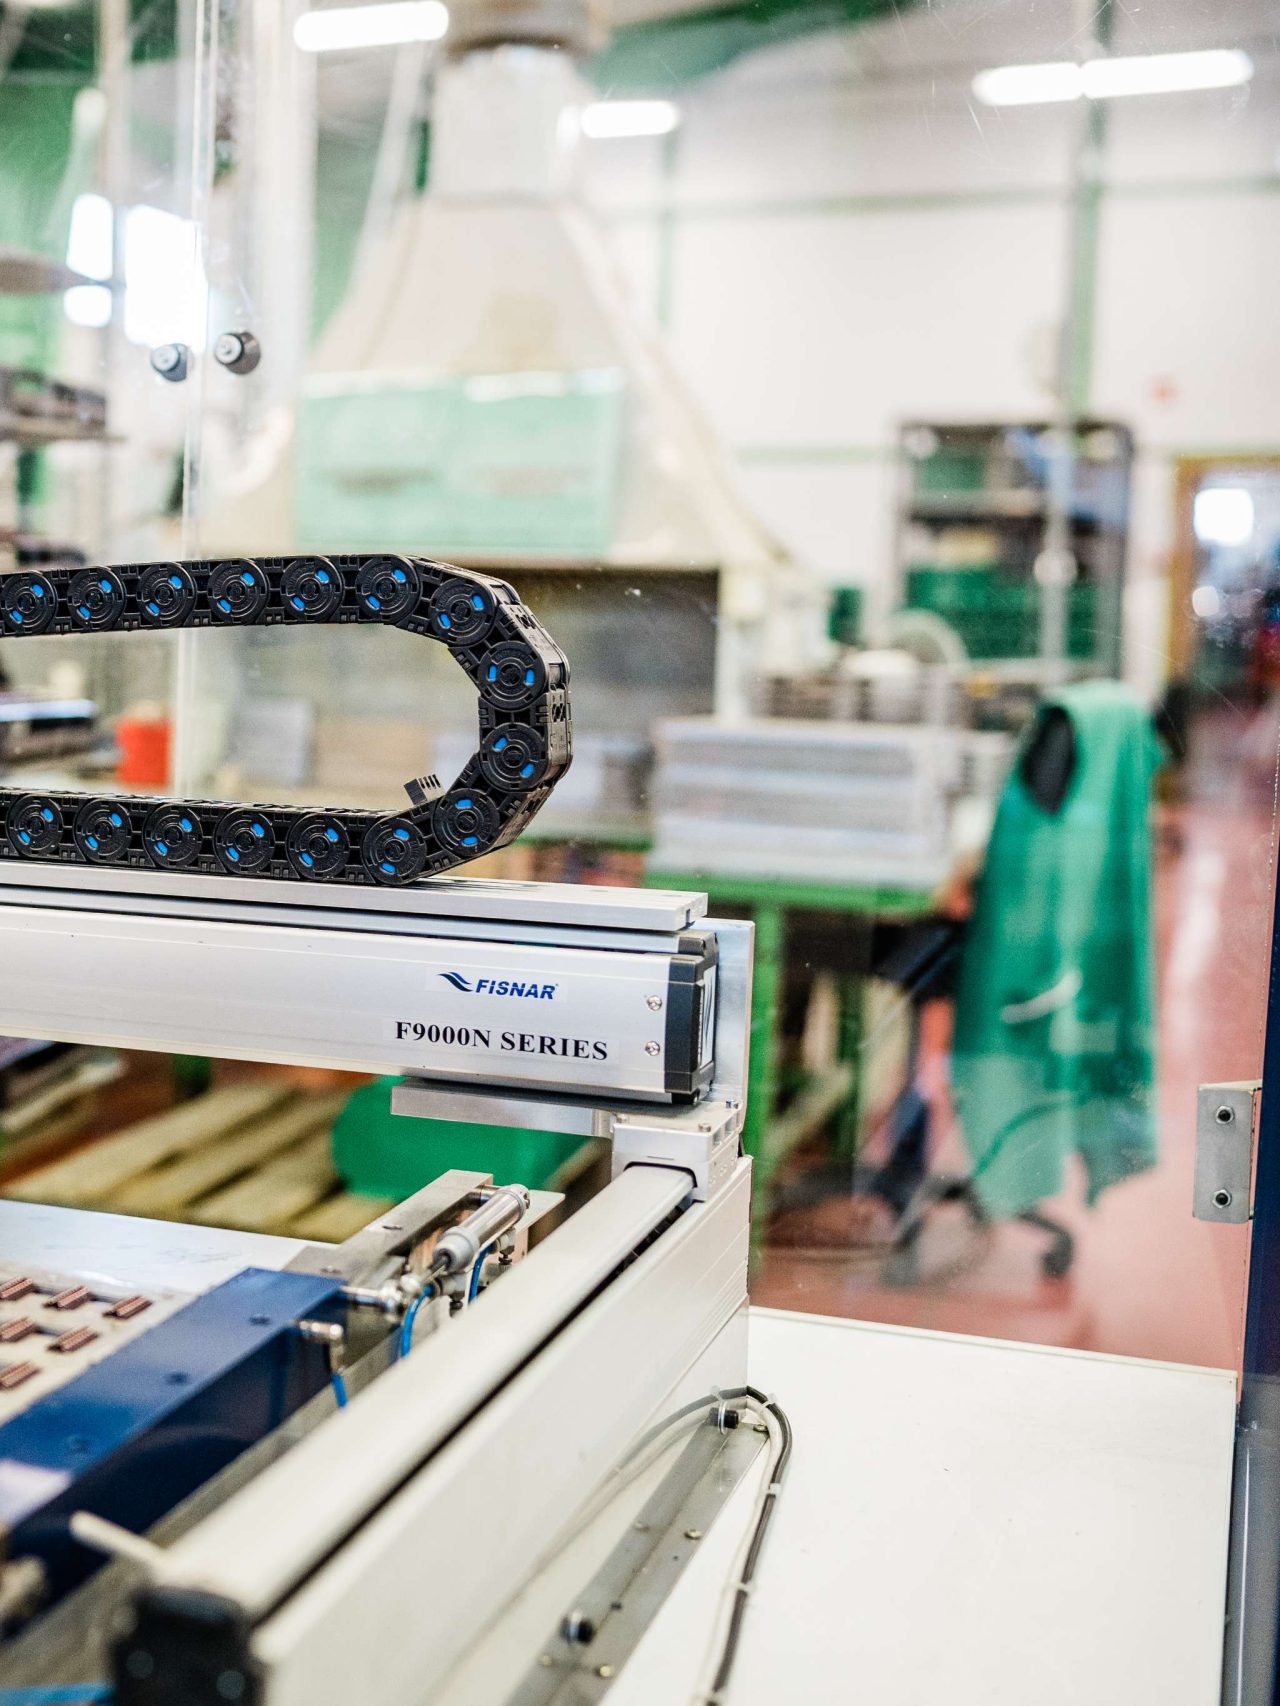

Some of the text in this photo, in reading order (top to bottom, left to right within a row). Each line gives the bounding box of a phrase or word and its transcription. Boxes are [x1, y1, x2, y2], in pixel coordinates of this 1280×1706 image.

[475, 979, 556, 1000] FISNAR
[395, 1021, 608, 1061] F9000N SERIES
